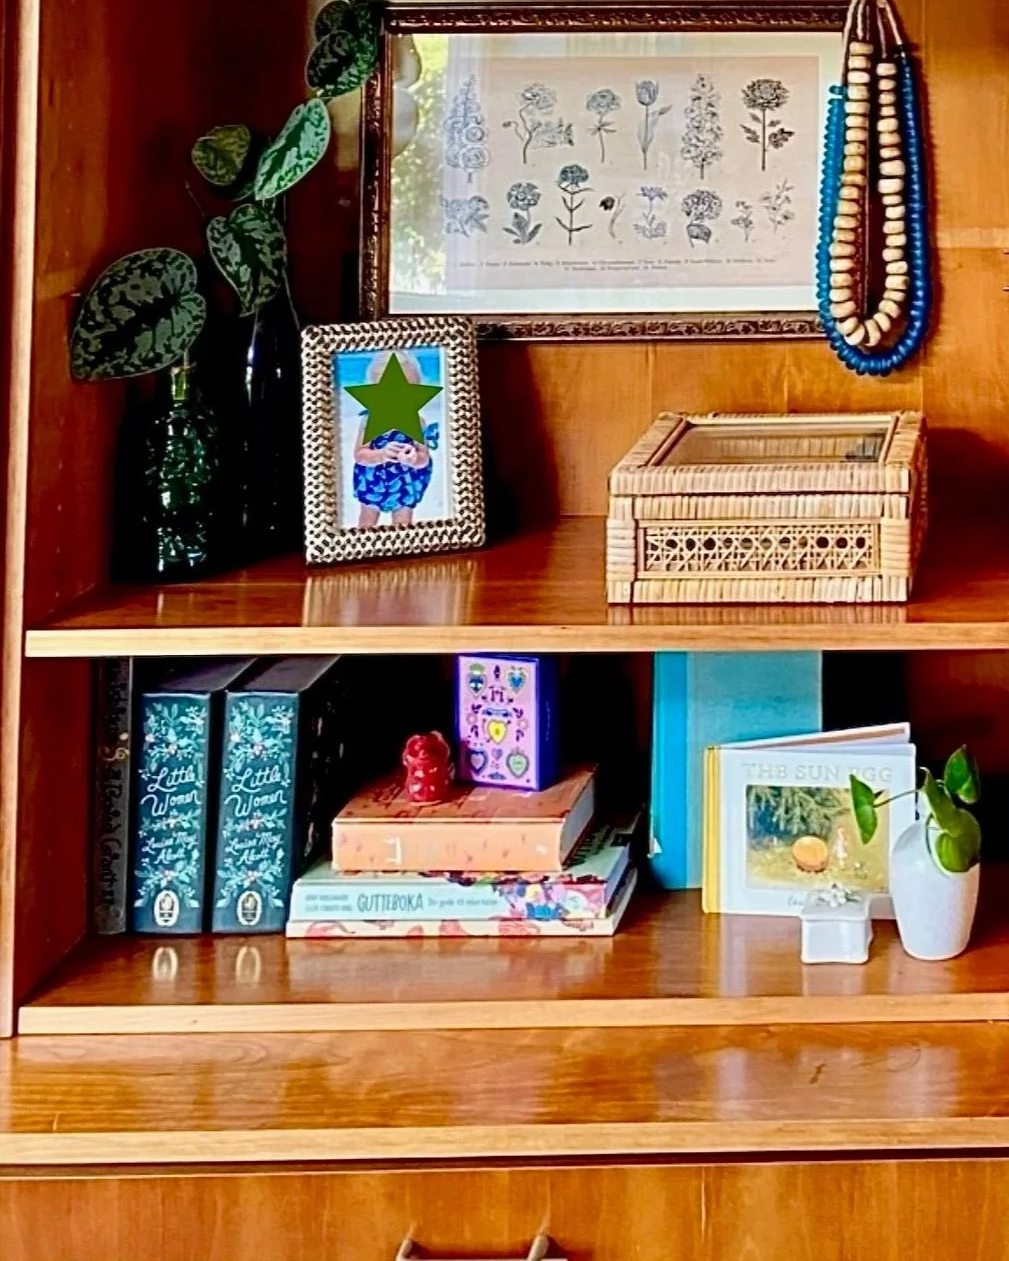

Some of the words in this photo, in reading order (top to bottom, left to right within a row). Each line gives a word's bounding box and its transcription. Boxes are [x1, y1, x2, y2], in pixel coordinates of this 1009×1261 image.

[147, 765, 196, 793] Little
[231, 765, 282, 793] Little
[743, 762, 787, 777] THE
[794, 763, 840, 779] SUN
[356, 893, 424, 912] GUTTEBOKA
